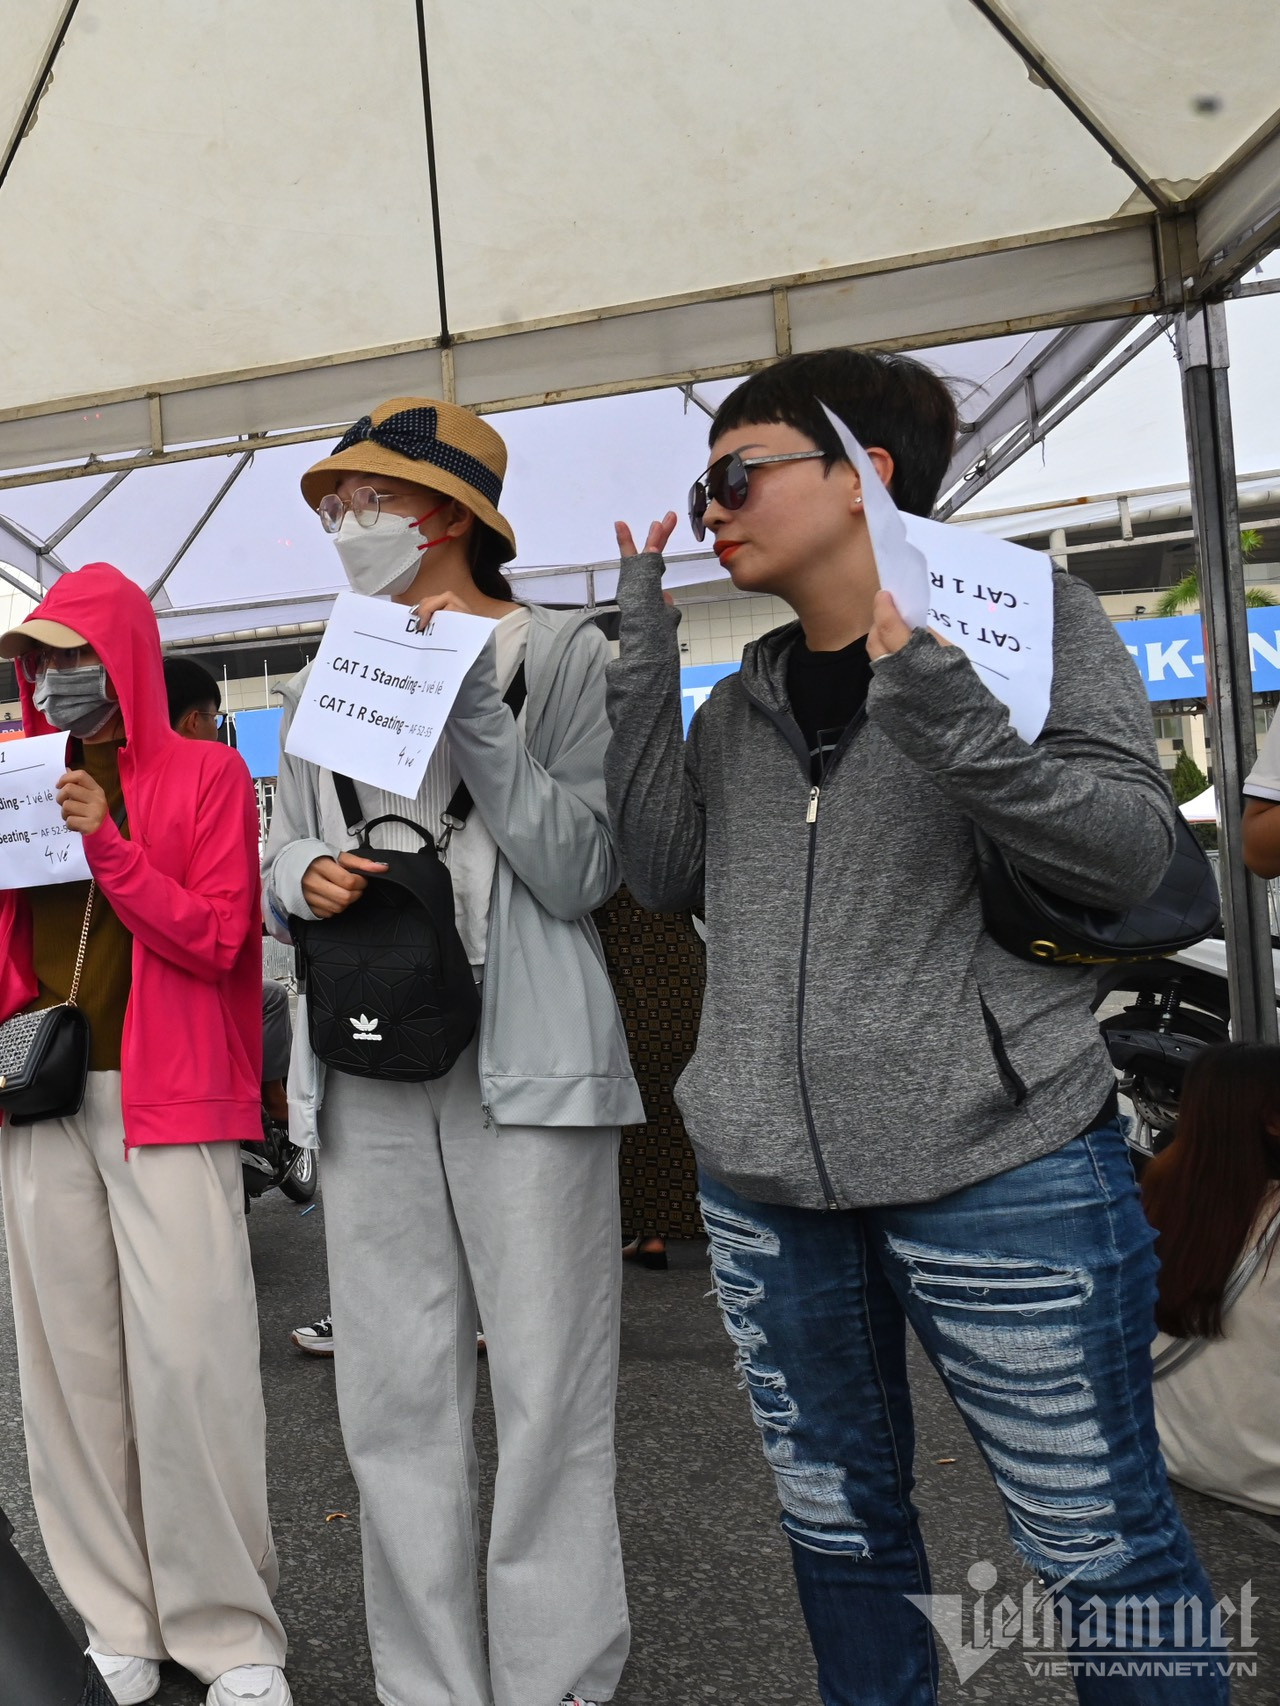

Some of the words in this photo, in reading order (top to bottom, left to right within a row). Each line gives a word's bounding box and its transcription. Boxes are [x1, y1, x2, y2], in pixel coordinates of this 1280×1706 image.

[930, 572, 944, 589] R
[952, 578, 964, 593] 1
[973, 585, 1017, 608] CAT
[957, 620, 969, 635] 1
[977, 628, 1020, 652] CAT
[332, 657, 360, 676] CAT
[360, 665, 368, 679] 1
[370, 668, 417, 695] Standing
[319, 695, 345, 713] CAT
[345, 703, 354, 717] 1
[357, 706, 367, 721] R
[367, 709, 404, 735] Seating
[1, 752, 6, 763] 1
[397, 746, 407, 766] 4
[41, 828, 50, 838] AF
[44, 845, 54, 864] 4
